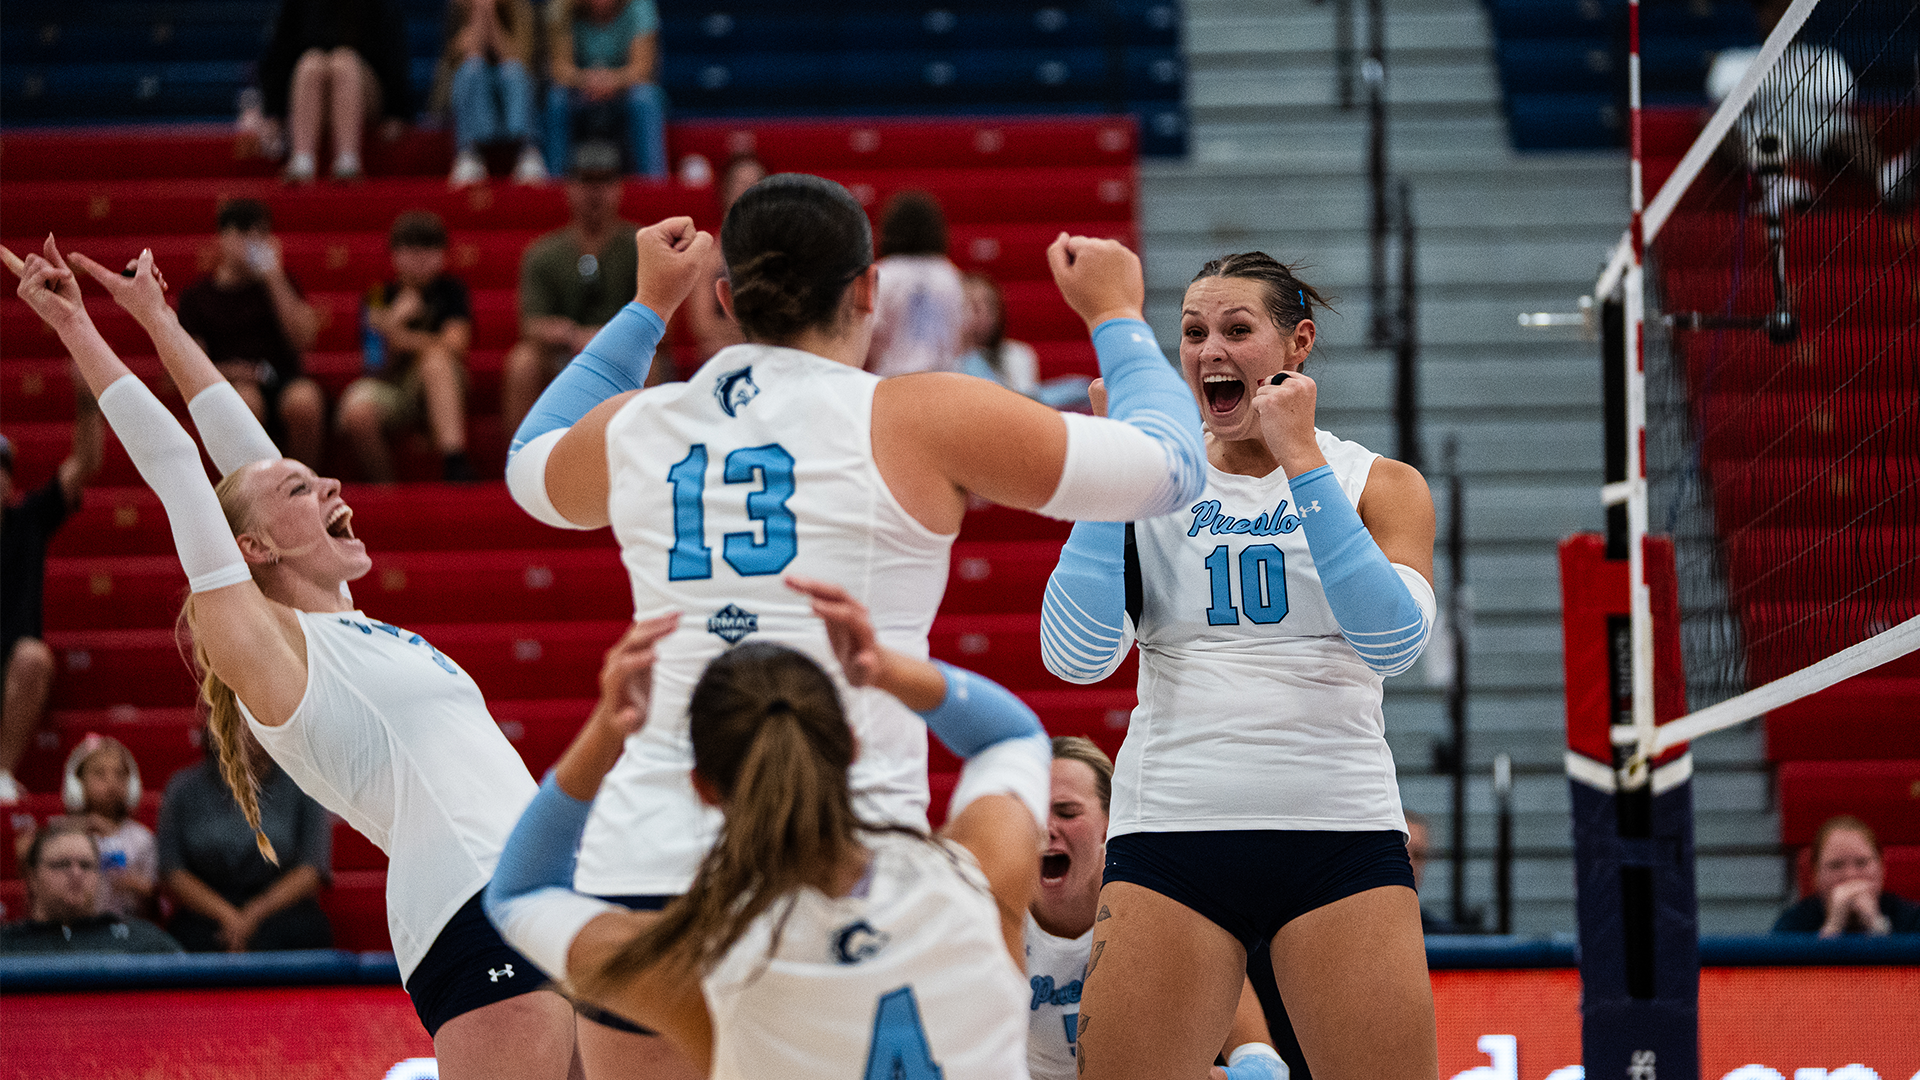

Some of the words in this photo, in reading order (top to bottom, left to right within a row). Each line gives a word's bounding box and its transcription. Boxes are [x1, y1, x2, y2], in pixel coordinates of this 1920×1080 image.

[667, 443, 798, 581] 13
[1205, 543, 1290, 626] 10
[1030, 970, 1084, 1010] Pue
